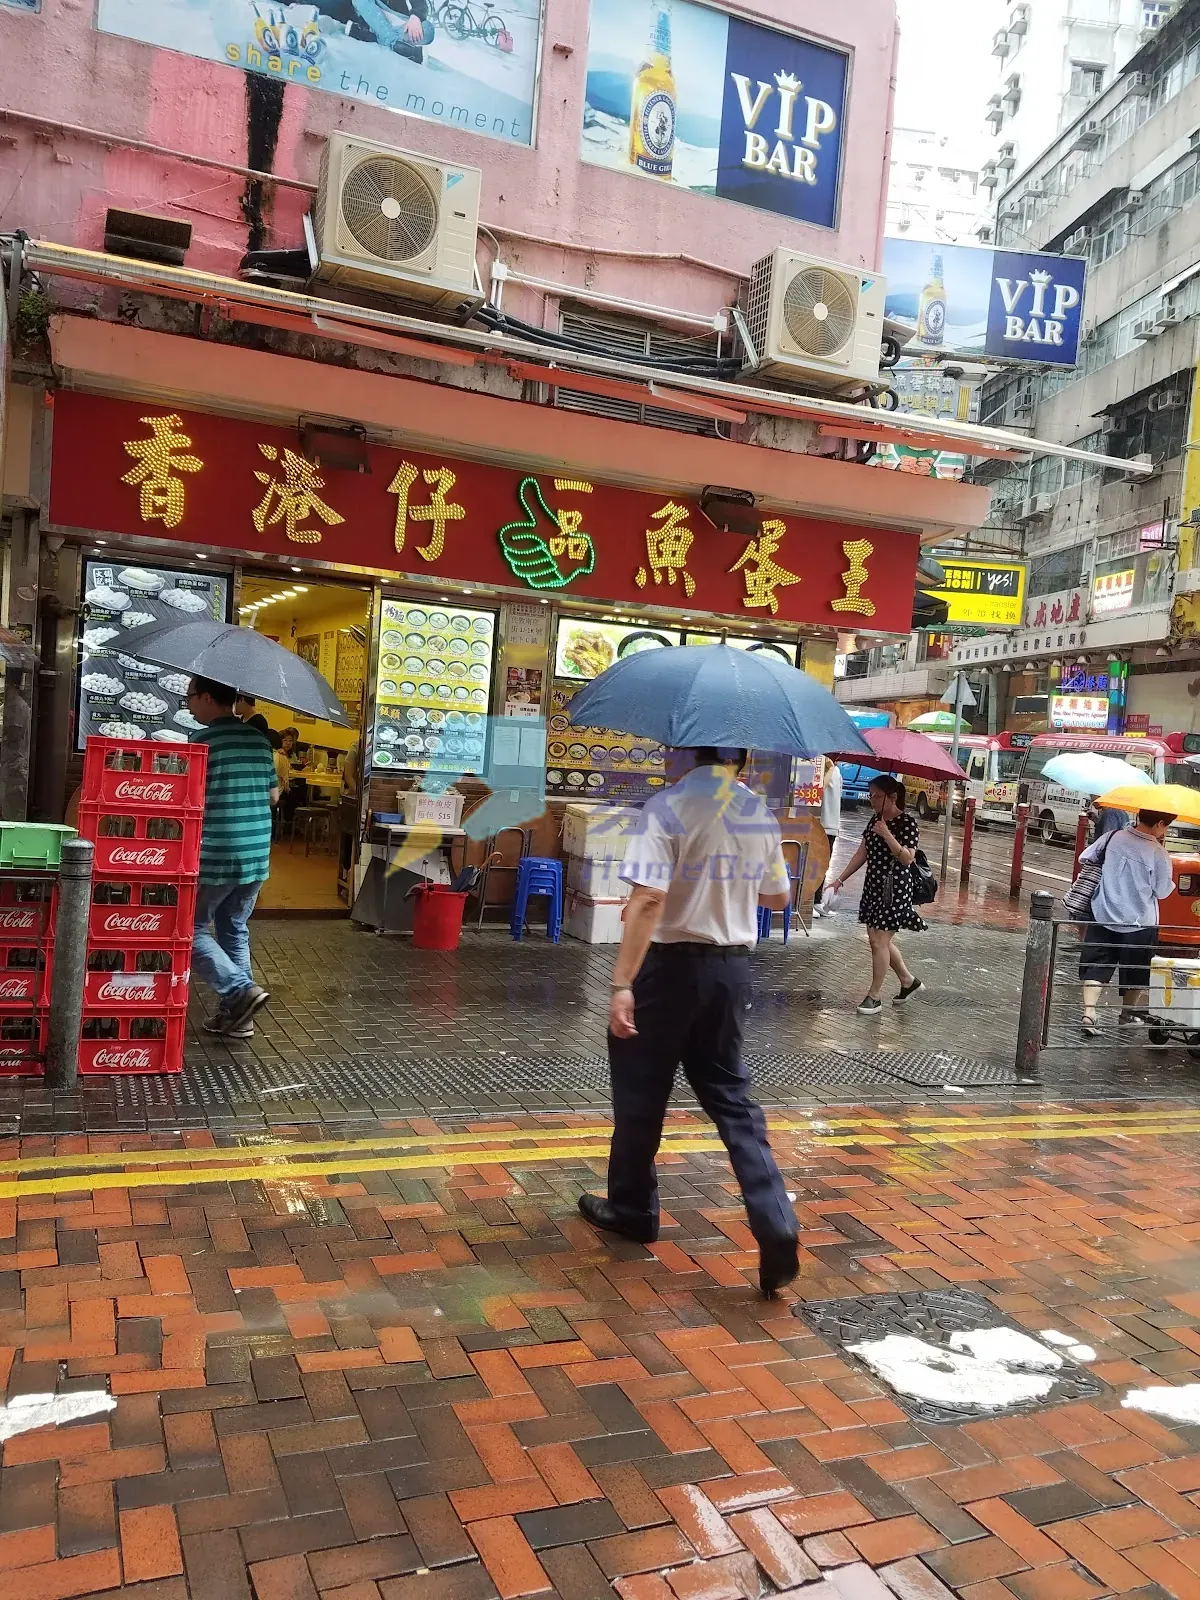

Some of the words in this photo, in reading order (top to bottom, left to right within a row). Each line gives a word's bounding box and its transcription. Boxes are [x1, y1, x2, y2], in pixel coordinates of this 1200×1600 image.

[225, 42, 323, 83] share
[340, 70, 389, 102] the
[405, 94, 522, 138] moment
[730, 71, 835, 146] VIP
[638, 158, 657, 171] BLUE
[742, 130, 818, 183] BAR
[995, 277, 1080, 321] VIP
[1003, 315, 1065, 347] BAR
[943, 568, 972, 580] ERN
[987, 571, 1014, 591] yes!
[115, 780, 175, 802] Coca-Cola
[438, 812, 451, 820] $15
[108, 847, 170, 866] Coca-Cola
[104, 912, 164, 932] Coca-Cola
[92, 1048, 152, 1068] Coca-Cola
